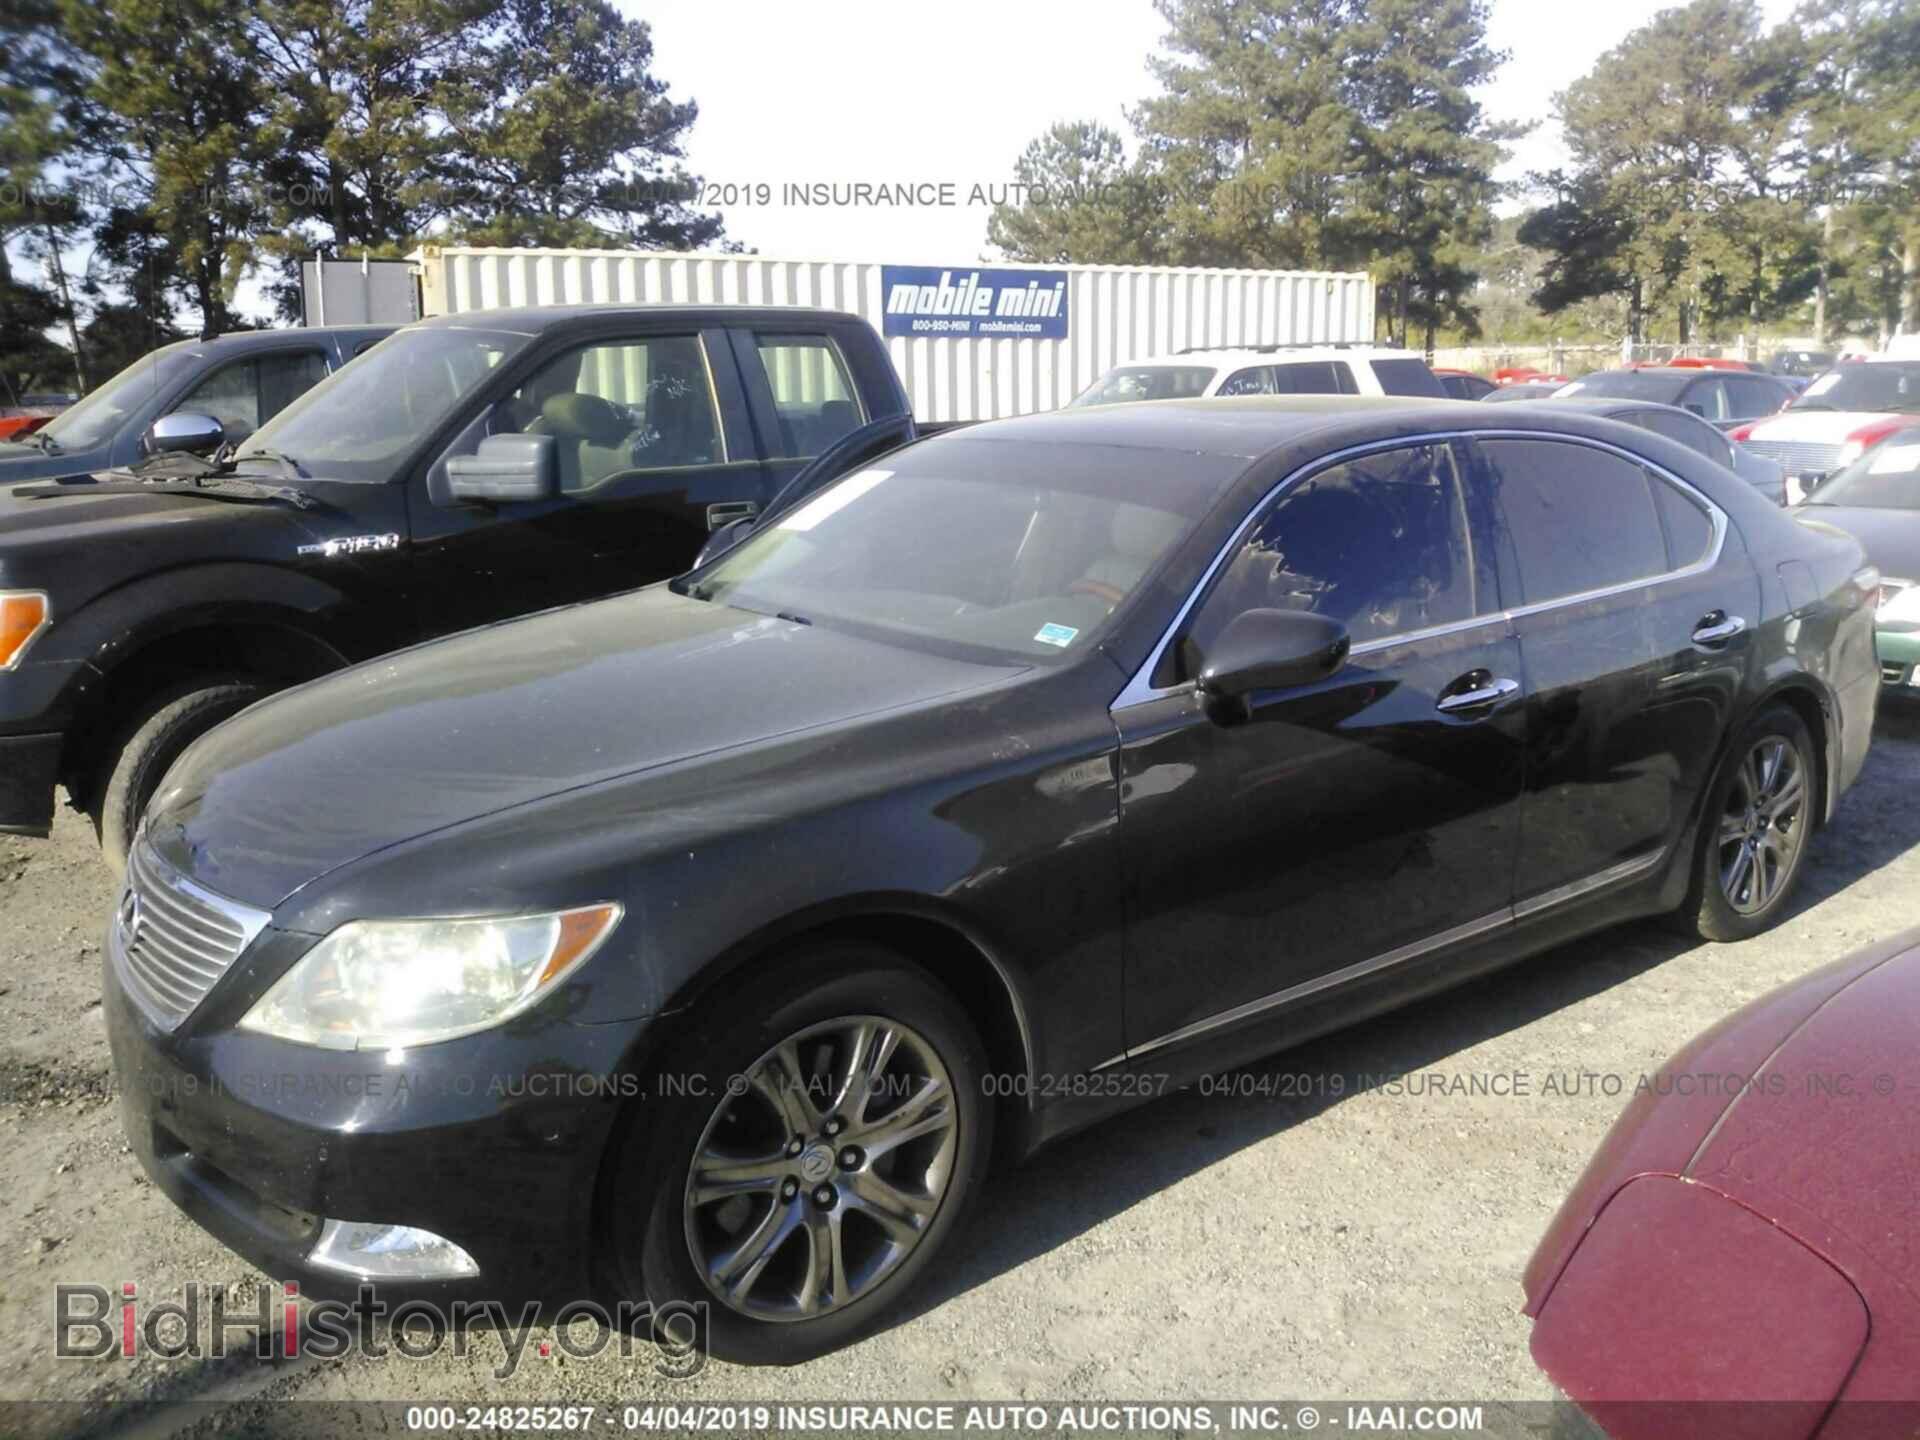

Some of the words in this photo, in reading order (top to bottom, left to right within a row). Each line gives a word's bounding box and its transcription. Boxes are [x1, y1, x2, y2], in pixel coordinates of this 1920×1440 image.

[886, 271, 993, 316] mobile
[912, 319, 970, 332] 800-950-MINI
[979, 320, 1042, 333] mobilemini.com
